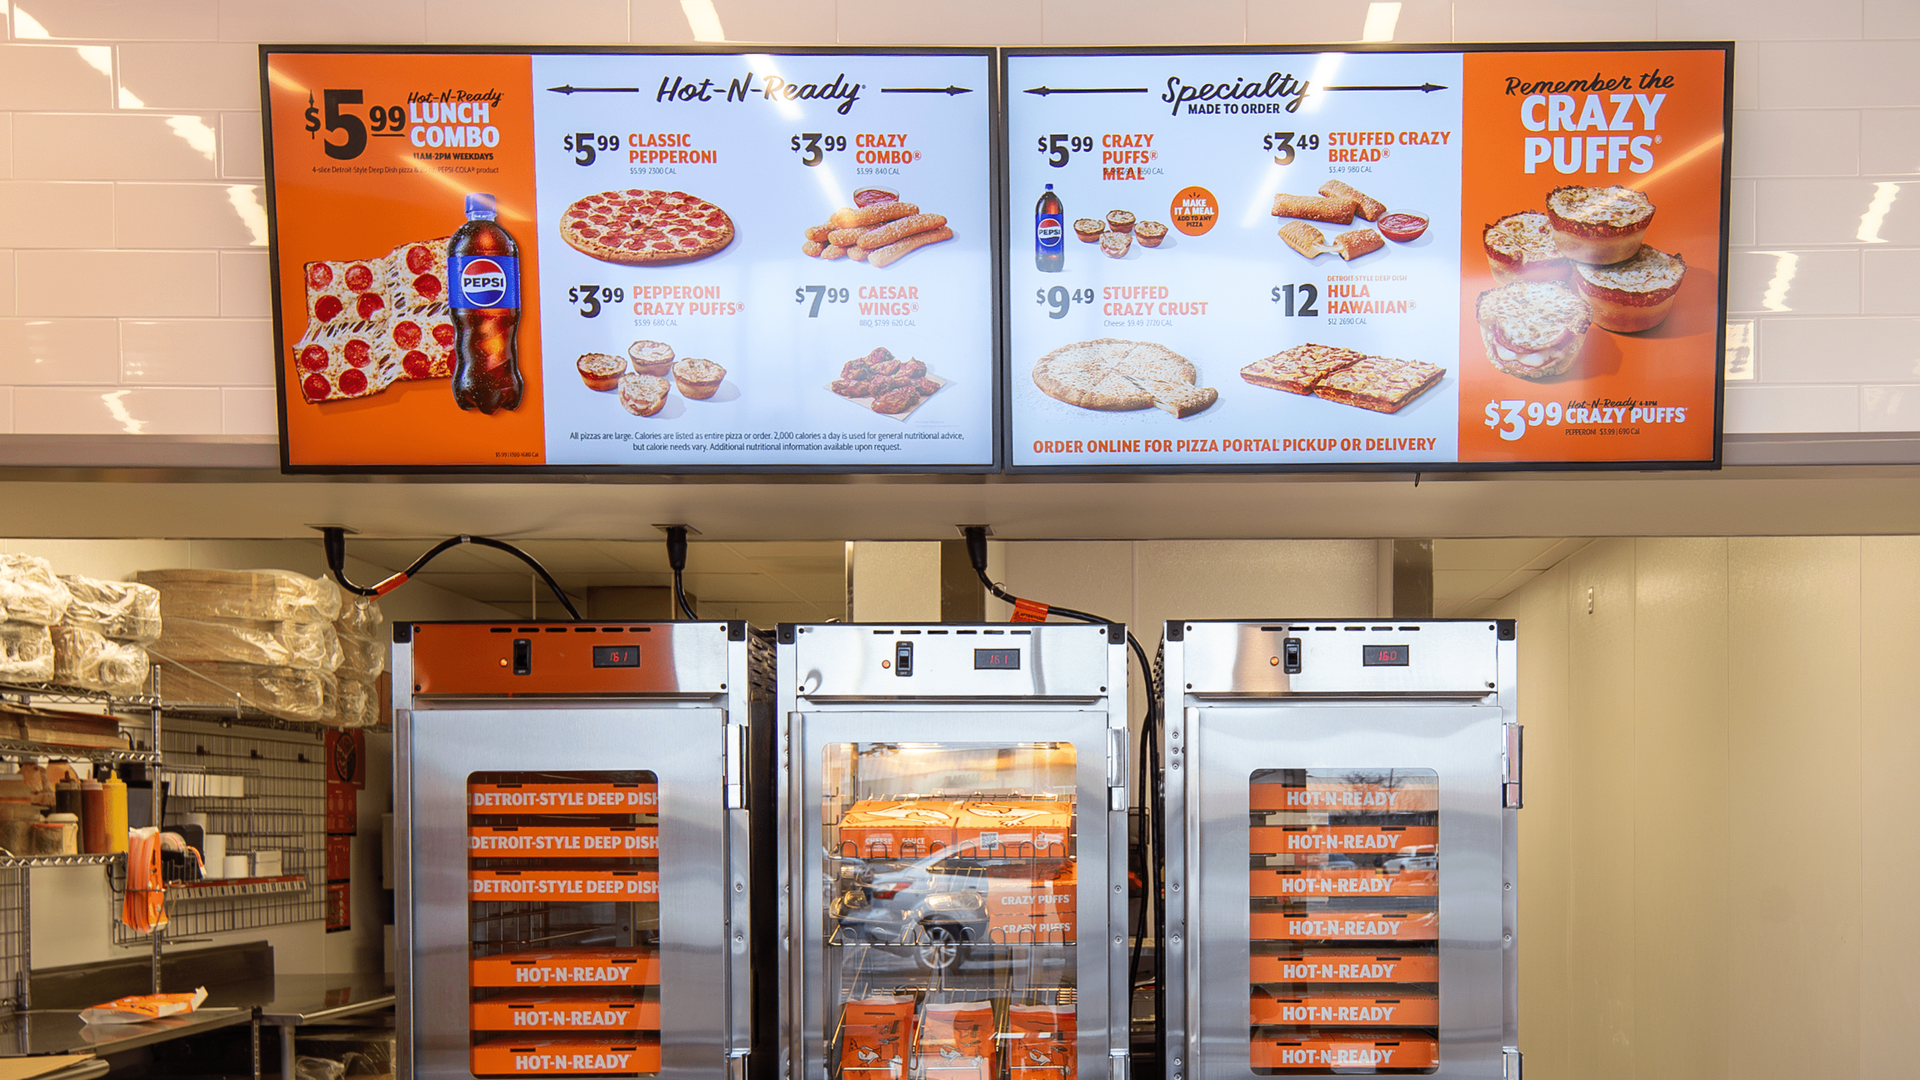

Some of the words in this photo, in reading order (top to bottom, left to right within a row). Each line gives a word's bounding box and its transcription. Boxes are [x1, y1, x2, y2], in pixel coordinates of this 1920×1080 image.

[1505, 72, 1633, 96] Remember
[1638, 68, 1675, 90] the
[1161, 71, 1310, 117] Specialty
[409, 101, 489, 123] LUNCH
[1188, 103, 1221, 114] MADE
[1223, 103, 1239, 114] TO
[1241, 103, 1280, 114] ORDER
[1521, 93, 1667, 131] CRAZY
[410, 125, 500, 148] COMBO
[628, 133, 691, 147] CLASSIC
[855, 133, 908, 147] CRAZY
[1102, 134, 1154, 148] CRAZY
[1328, 131, 1395, 146] STUFFED
[1399, 131, 1451, 145] CRAZY
[413, 152, 451, 160] 11AM-2PM
[452, 152, 494, 160] WEEKDAYS
[629, 150, 717, 164] PEPPERONI
[664, 167, 677, 175] CAL
[888, 167, 900, 175] CAL
[1103, 166, 1145, 180] MEAL
[1360, 166, 1372, 174] CAL
[1182, 198, 1207, 207] MAKE
[1174, 206, 1183, 215] IT
[1184, 206, 1191, 215] A
[1192, 206, 1215, 215] MEAL
[463, 277, 504, 288] PEPSI
[633, 286, 720, 299] PEPPERONI
[858, 286, 919, 299] CAESAR
[1103, 286, 1169, 299] STUFFED
[1328, 284, 1370, 298] HULA
[1271, 283, 1318, 317] $12
[633, 302, 685, 315] CRAZY
[1103, 302, 1155, 316] CRAZY
[1158, 302, 1208, 315] CRUST
[904, 319, 916, 327] CAL
[1104, 319, 1125, 327] Cheese
[1161, 319, 1173, 327] CAL
[1565, 407, 1627, 424] CRAZY
[569, 432, 578, 440] All
[580, 432, 601, 441] pizzas
[614, 432, 633, 441] large.
[634, 432, 662, 440] Calories
[675, 432, 694, 440] listed
[704, 432, 724, 440] entire
[725, 432, 742, 441] pizza
[752, 432, 773, 440] order.
[774, 432, 794, 441] 2,000
[795, 432, 821, 440] calories
[828, 432, 840, 441] day
[841, 432, 848, 440] is
[848, 432, 866, 440] used
[867, 432, 876, 440] for
[878, 432, 904, 441] general
[904, 431, 939, 440] nutritional
[940, 431, 965, 440] advice,
[1565, 428, 1596, 436] PEPPERONI
[1630, 427, 1640, 435] Cal
[632, 443, 645, 451] but
[646, 443, 668, 451] calorie
[670, 443, 691, 451] needs
[709, 443, 745, 451] Additional
[746, 443, 781, 451] nutritional
[782, 443, 822, 451] information
[823, 443, 853, 451] available
[854, 444, 872, 452] upon
[873, 443, 902, 452] request.
[1033, 440, 1084, 453] ORDER
[1087, 440, 1141, 453] ONLINE
[1144, 439, 1173, 452] FOR
[1177, 439, 1219, 452] PIZZA
[1283, 438, 1337, 451] PICKUP
[1340, 438, 1362, 451] OR
[1365, 437, 1437, 451] DELIVERY
[474, 792, 584, 806] DETROIT-STYLE
[587, 792, 624, 806] DEEP
[1287, 791, 1398, 806] HOT-N-READY
[471, 836, 580, 849] DETROIT-STYLE
[584, 836, 621, 849] DEEP
[1288, 834, 1400, 849] HOT-N-READY
[473, 880, 583, 893] DETROIT-STYLE
[586, 880, 624, 893] DEEP
[1282, 878, 1394, 893] HOT-N-READY
[1001, 895, 1036, 905] CRAZY
[1038, 894, 1070, 904] PUFFS
[1003, 923, 1037, 933] CRAZY
[1289, 920, 1401, 935] HOT-N-READY
[516, 967, 631, 982] HOT-N-READY
[1283, 964, 1396, 978] HOT-N-READY
[514, 1011, 629, 1026] HOT-N-READY
[1282, 1006, 1395, 1021] HOT-N-READY
[515, 1054, 631, 1070] HOT-N-READY
[1282, 1049, 1394, 1064] HOT-N-READY
